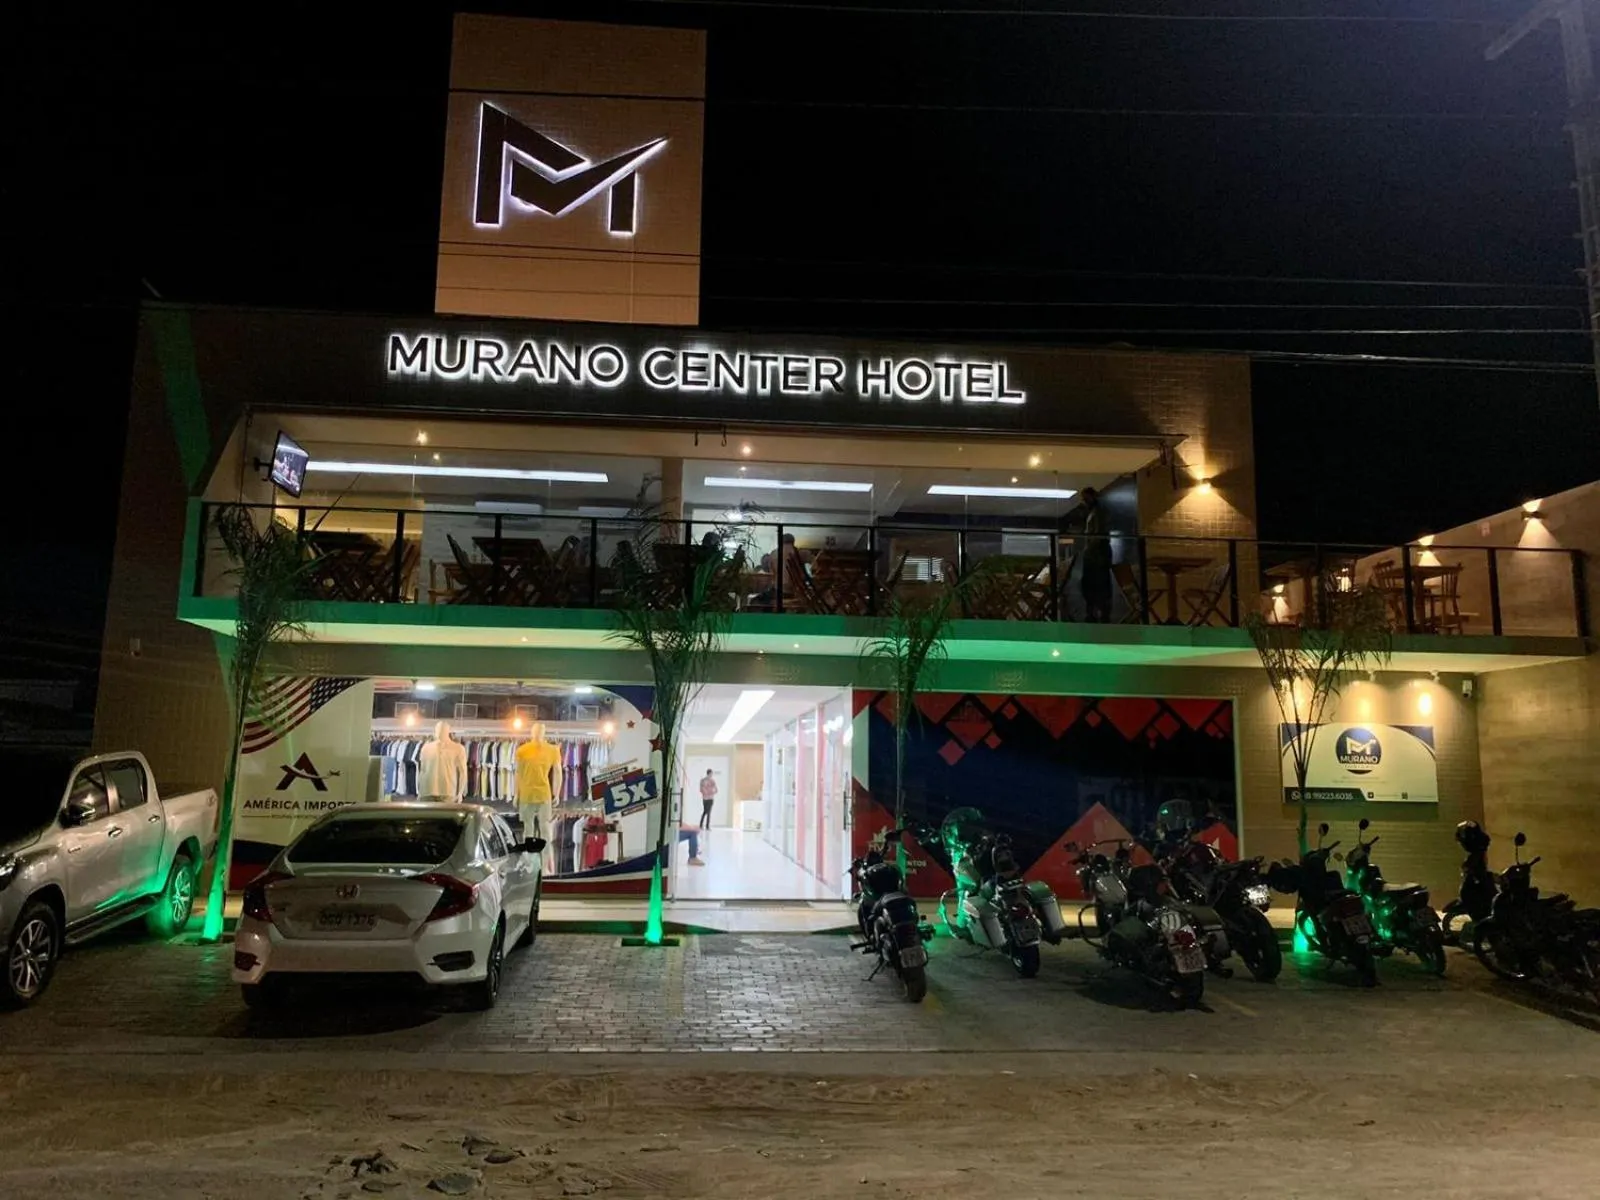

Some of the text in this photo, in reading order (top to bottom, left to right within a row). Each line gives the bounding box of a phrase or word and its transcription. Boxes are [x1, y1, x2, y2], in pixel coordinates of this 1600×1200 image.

[388, 335, 1023, 401] MURANO CENTER HOTEL
[1340, 755, 1378, 764] MURANO
[243, 797, 357, 811] AMÉRICA IMPO
